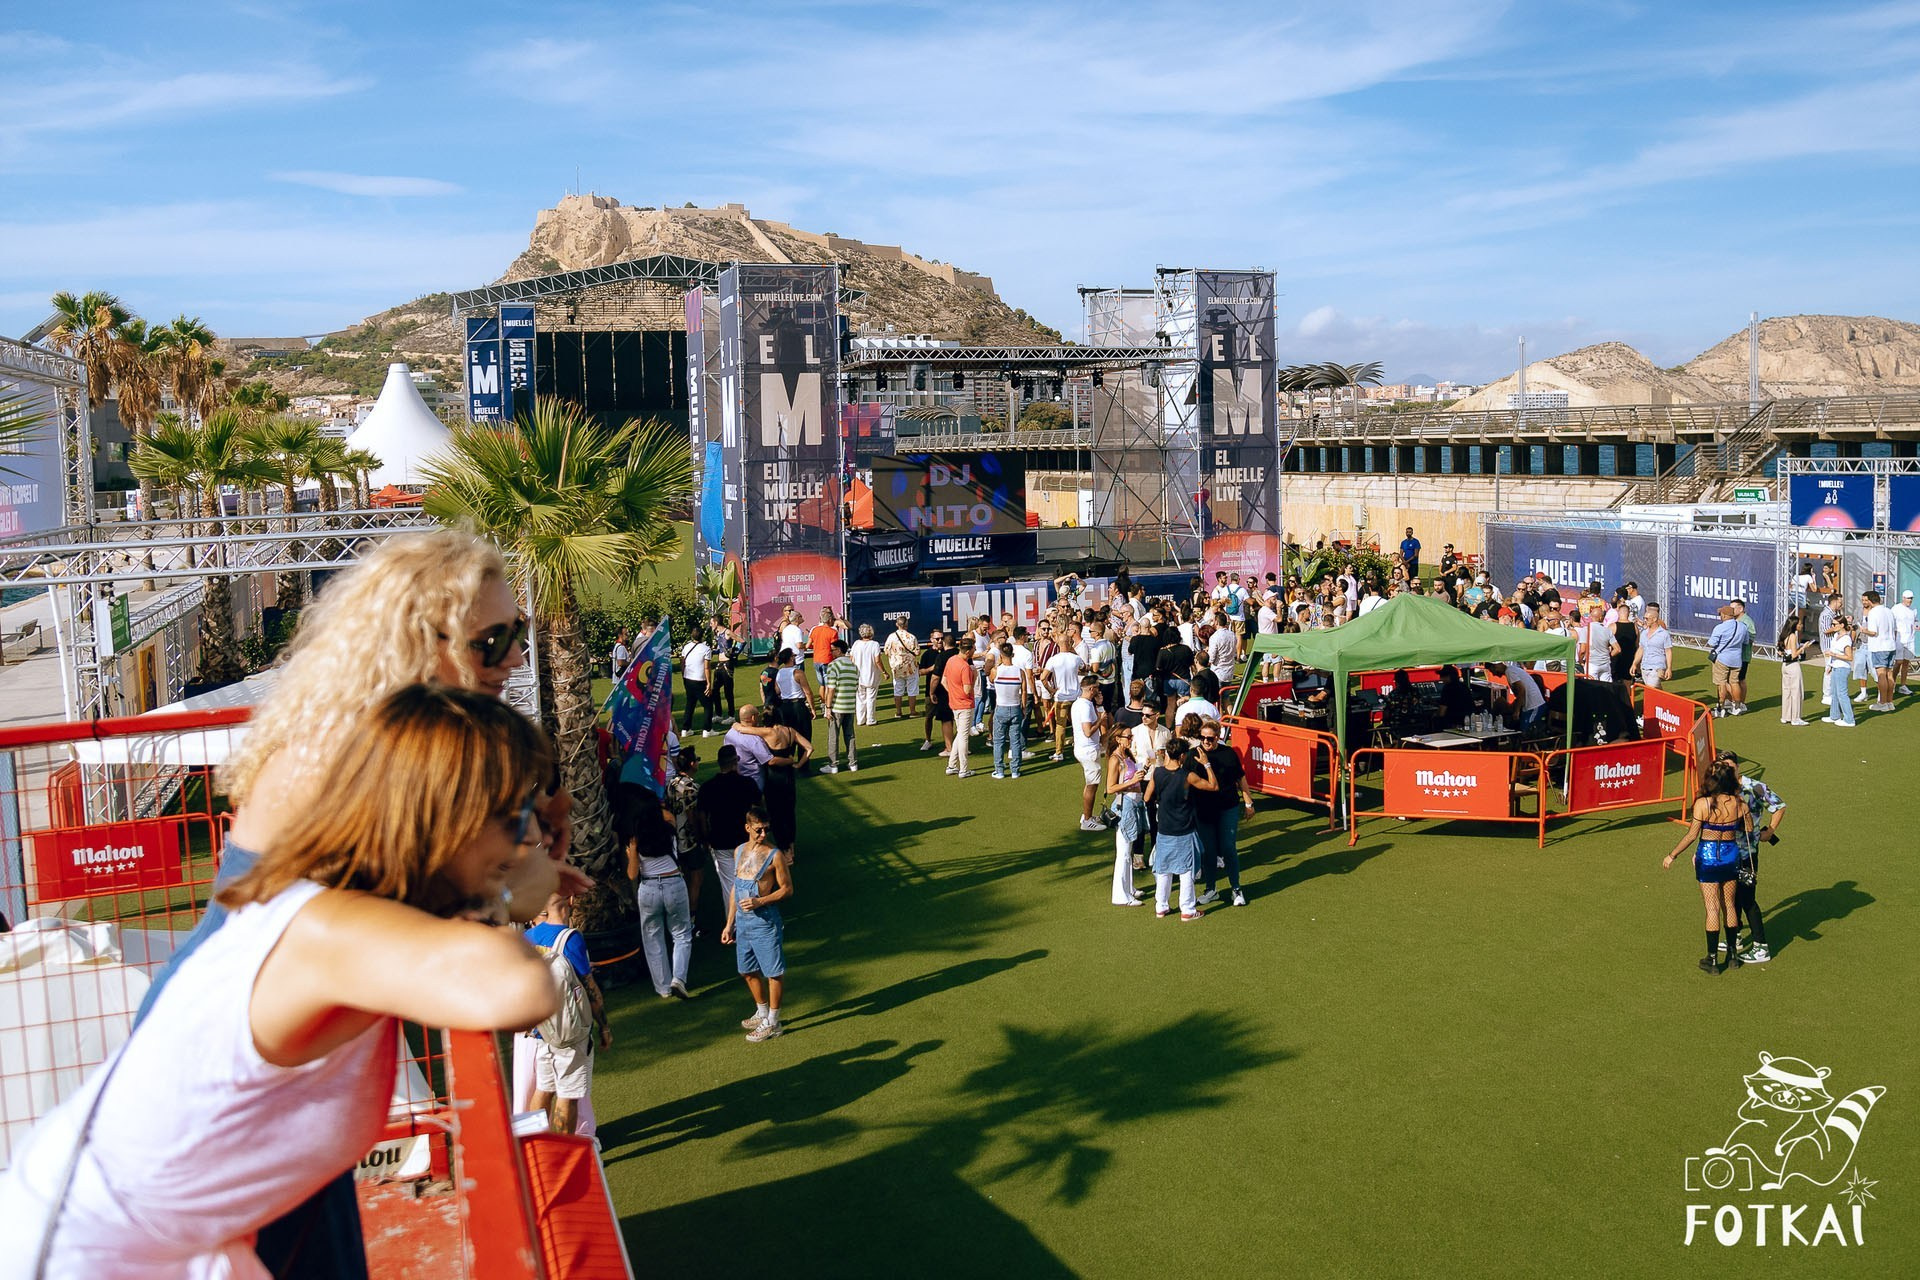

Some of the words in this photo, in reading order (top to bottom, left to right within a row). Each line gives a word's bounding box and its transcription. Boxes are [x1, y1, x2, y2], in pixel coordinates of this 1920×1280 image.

[754, 293, 822, 301] ELMUELLELIVE.COM
[472, 365, 499, 394] M
[760, 372, 823, 447] M
[1213, 368, 1264, 436] M
[1215, 449, 1231, 466] EL
[763, 463, 782, 480] EL
[929, 464, 971, 487] DJ
[1215, 466, 1265, 483] MUELLE
[764, 481, 824, 500] MUELLE
[1216, 485, 1243, 502] LIVE
[764, 502, 797, 521] LIVE
[910, 503, 993, 529] NITO
[934, 537, 983, 553] MUELLE
[788, 574, 815, 582] ESPACIO
[780, 585, 812, 593] CULTURAL
[1690, 575, 1748, 602] MUELLE
[1655, 705, 1681, 727] Mahou
[1251, 746, 1291, 767] Mahou
[1415, 770, 1478, 787] Mahou
[1594, 762, 1641, 780] Mahou
[72, 845, 144, 866] Mahou
